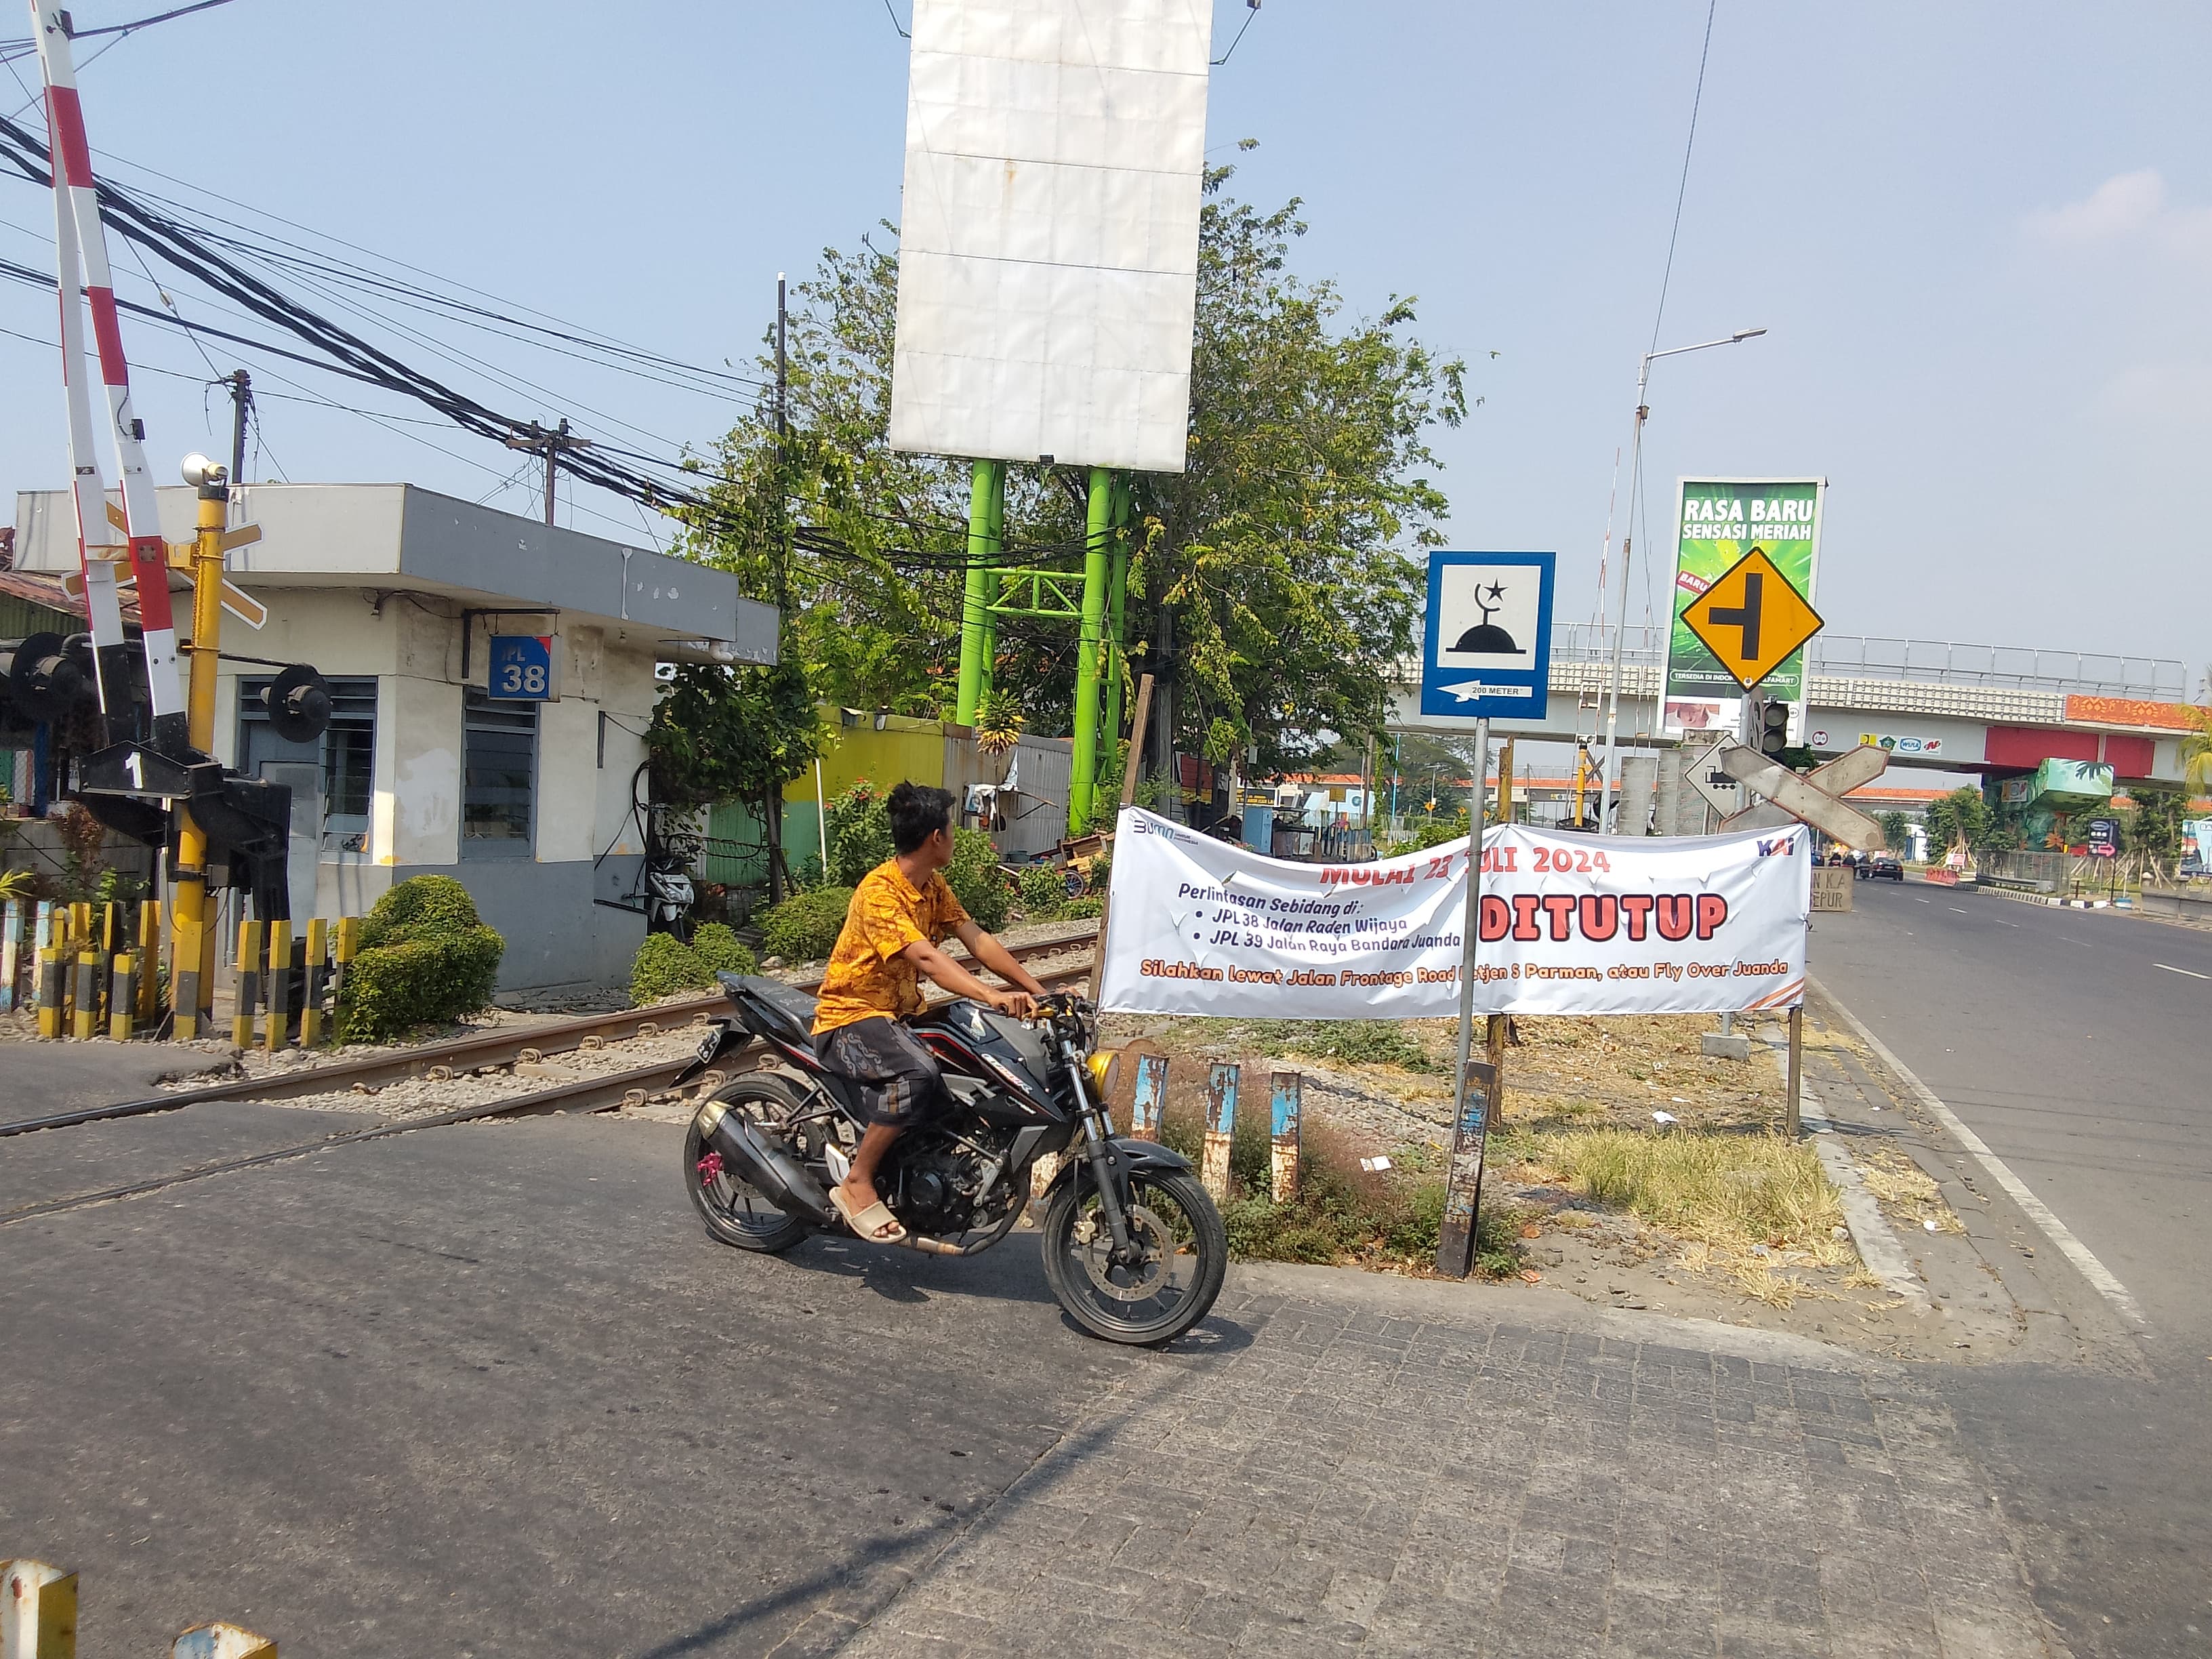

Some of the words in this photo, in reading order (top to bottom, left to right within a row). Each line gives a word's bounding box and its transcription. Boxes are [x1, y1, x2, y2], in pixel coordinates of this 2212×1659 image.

[1683, 499, 1744, 523] RASA
[1750, 499, 1813, 523] BARU
[1682, 523, 1747, 541] SENSASI
[1750, 524, 1811, 541] MERIAH
[1679, 573, 1708, 592] BARU
[501, 663, 545, 693] 38
[124, 751, 143, 789] 1
[1319, 864, 1416, 886] MULAI
[1424, 855, 1454, 880] 23
[1464, 846, 1517, 874] ULI
[1533, 846, 1611, 873] 2024
[1178, 883, 1267, 910] Perlintasan
[1269, 898, 1340, 918] Sebidang
[1343, 901, 1364, 916] di:
[1813, 892, 1843, 907] EPUR
[1212, 909, 1240, 925] JPL
[1243, 914, 1259, 928] 38
[1263, 916, 1303, 933] Jalan
[1305, 919, 1351, 935] Raden
[1355, 918, 1408, 935] Wijaya
[1479, 893, 1728, 942] DITUTUP
[1210, 930, 1239, 947] JPL
[1244, 933, 1263, 948] 39
[1267, 936, 1306, 951] Jalan
[1309, 940, 1347, 956] Raya
[1351, 936, 1409, 951] Bandara
[1411, 932, 1461, 949] Juanda
[1140, 959, 1224, 982] Silahkan
[1229, 965, 1284, 985] lewat
[1286, 969, 1336, 987] Jalan
[1340, 969, 1412, 988] Frontage
[1417, 965, 1456, 983] Road
[1511, 963, 1521, 979] S
[1525, 962, 1603, 982] Parman,
[1607, 964, 1649, 979] atau
[1654, 962, 1683, 982] Fly
[1687, 962, 1731, 978] Over
[1733, 958, 1788, 977] Juanda
